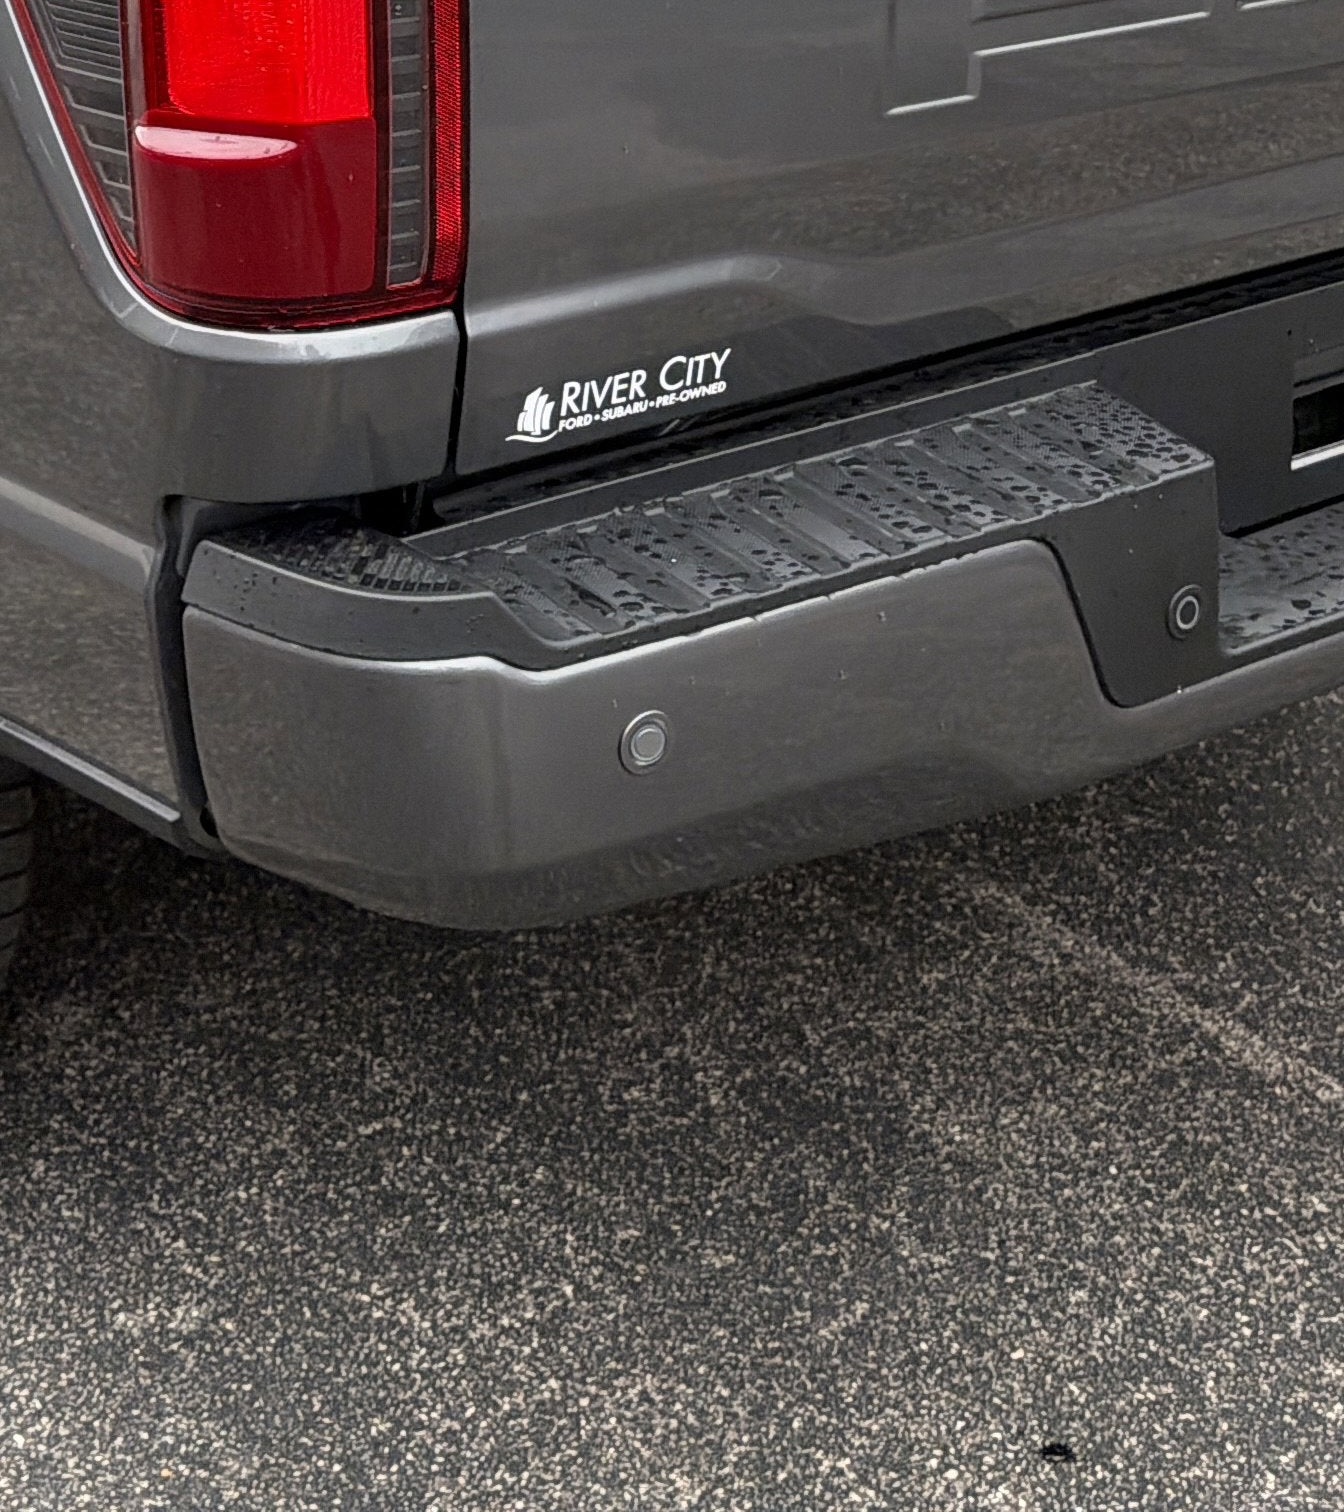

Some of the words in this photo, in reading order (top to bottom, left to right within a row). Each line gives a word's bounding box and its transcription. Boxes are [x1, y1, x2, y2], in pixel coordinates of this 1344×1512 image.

[559, 414, 592, 432] FORD
[601, 400, 648, 421] SUBARU
[656, 381, 727, 408] PRE-OWNED
[560, 370, 647, 416] RIVER
[659, 348, 731, 390] CITY
